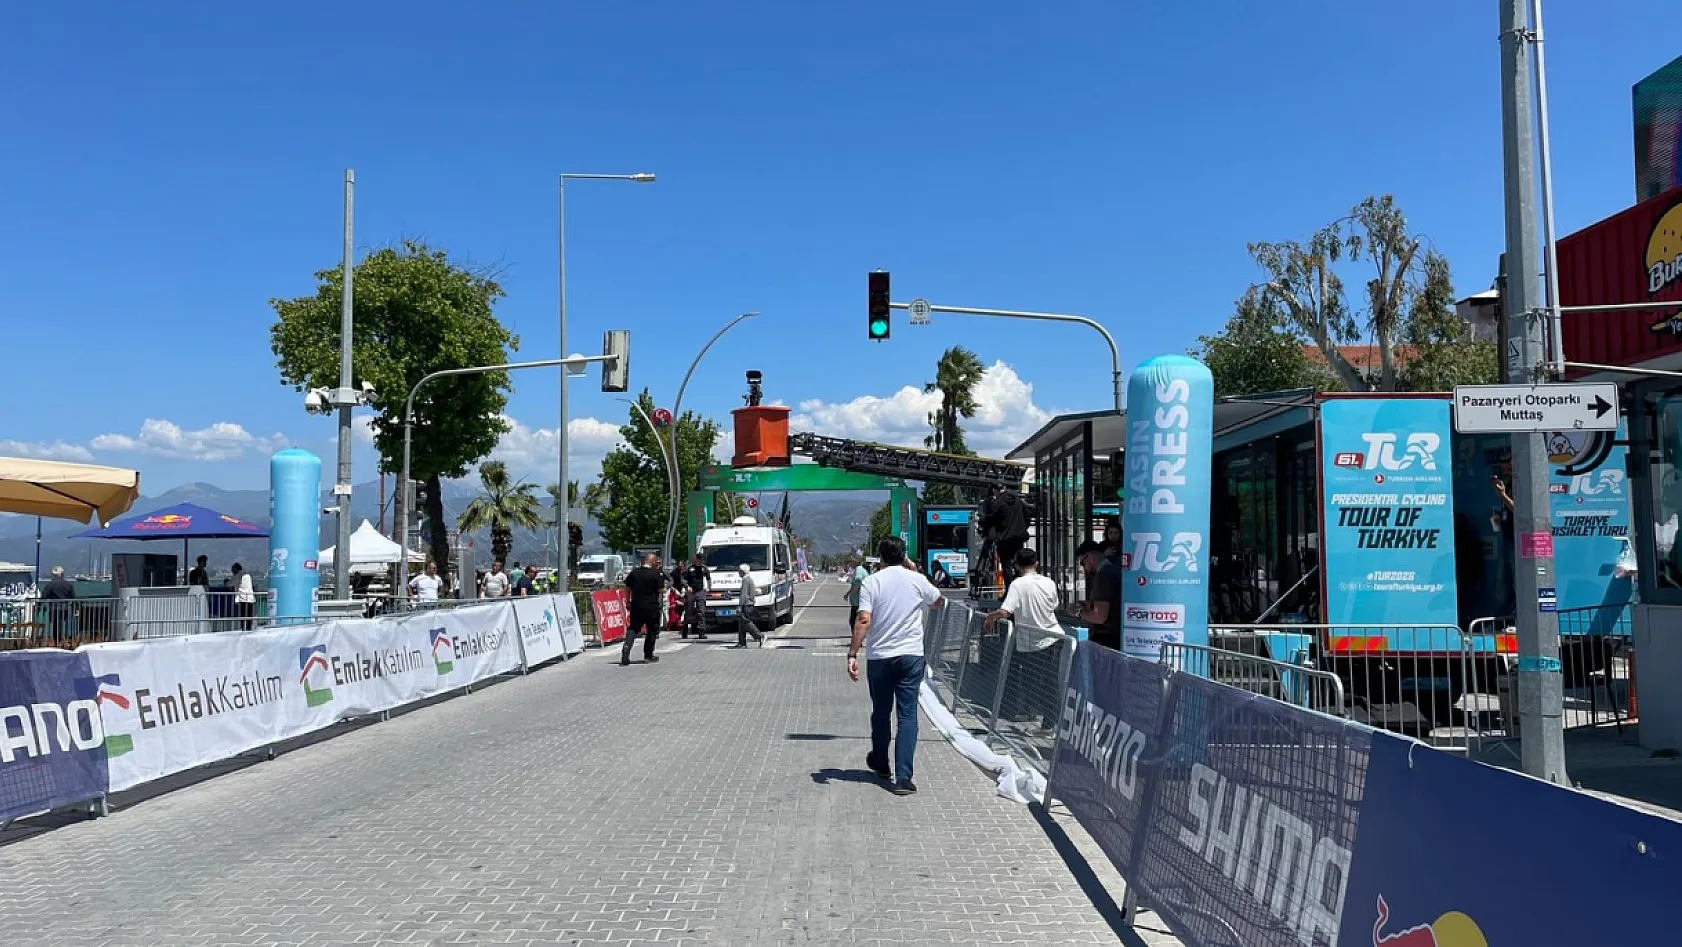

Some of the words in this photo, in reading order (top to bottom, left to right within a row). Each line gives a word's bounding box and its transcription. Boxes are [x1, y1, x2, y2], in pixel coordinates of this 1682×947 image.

[1461, 394, 1521, 408] Pazaryeri
[1525, 394, 1581, 407] Otoparkı
[1500, 409, 1543, 421] Muttaş
[1151, 379, 1190, 514] PRESS
[1361, 432, 1440, 470] TUR
[1130, 421, 1150, 514] BASIN
[1338, 507, 1391, 527] TOUR
[1395, 507, 1423, 527] OF
[1402, 493, 1447, 505] CYCLING
[1598, 525, 1628, 536] TURU
[1130, 532, 1202, 572] TUR
[330, 645, 424, 686] EmlakKatılım
[135, 670, 283, 730] EmlakKatılım
[1059, 687, 1147, 800] SHIMANO
